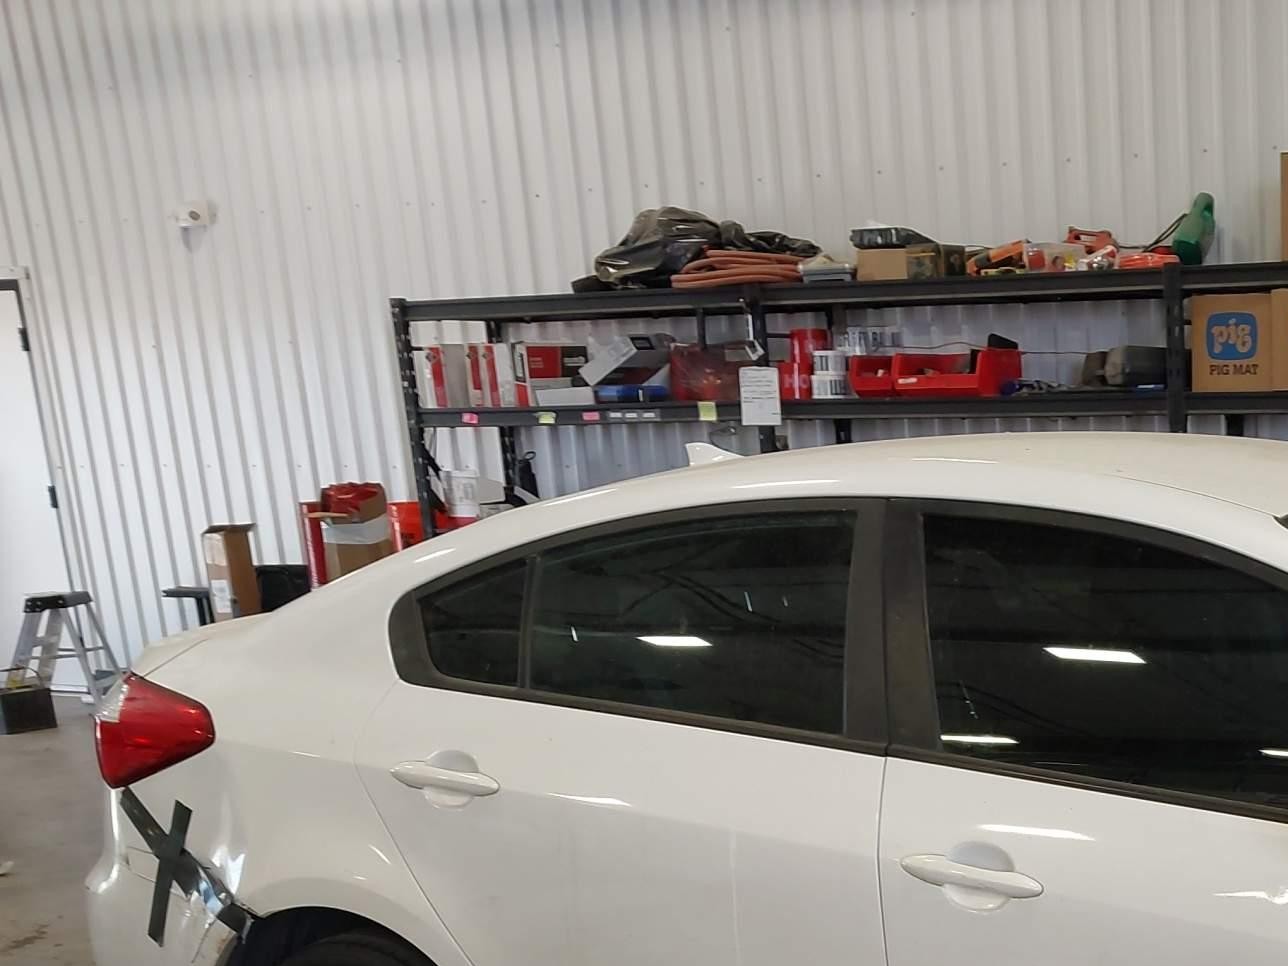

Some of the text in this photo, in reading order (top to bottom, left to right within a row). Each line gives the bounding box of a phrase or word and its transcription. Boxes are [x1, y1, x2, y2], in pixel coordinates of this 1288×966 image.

[1210, 317, 1252, 354] pig
[1209, 363, 1259, 376] PIG MAT
